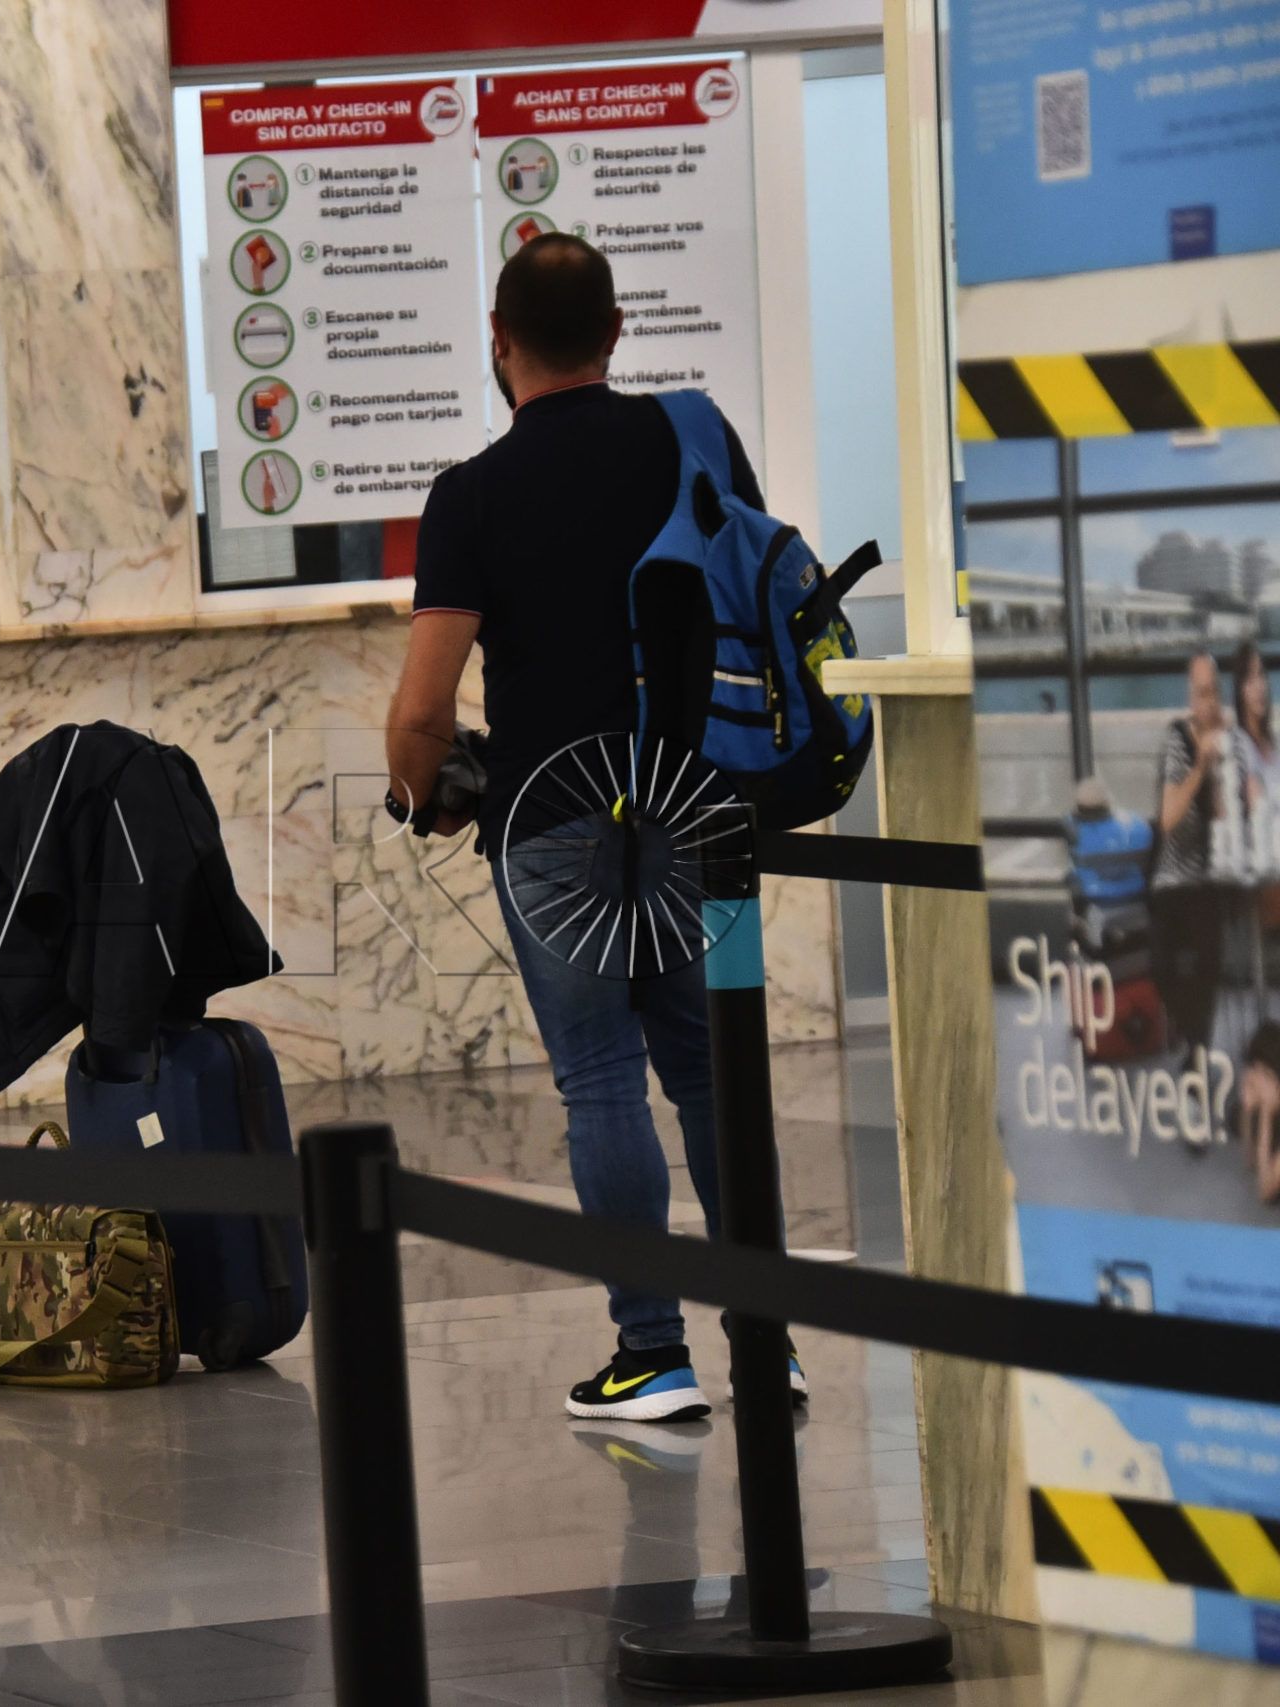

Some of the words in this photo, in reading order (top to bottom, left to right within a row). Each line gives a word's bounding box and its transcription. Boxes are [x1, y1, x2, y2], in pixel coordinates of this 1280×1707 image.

[514, 89, 574, 107] ACHAT
[577, 87, 599, 102] ET
[602, 82, 686, 101] CHECK-IN
[230, 106, 308, 124] COMPRA
[312, 104, 323, 119] Y
[328, 101, 411, 118] CHECK-IN
[534, 107, 581, 124] SANS
[585, 102, 667, 120] CONTACT
[257, 124, 287, 141] SIN
[291, 120, 386, 139] CONTACTO
[594, 146, 677, 161] Respectez
[682, 143, 706, 155] les
[319, 166, 399, 182] Mantenga
[403, 164, 417, 177] la
[594, 164, 673, 179] distances
[677, 161, 697, 174] de
[320, 181, 395, 199] distancia
[399, 181, 419, 195] de
[595, 181, 661, 197] sécurité
[320, 201, 402, 218] seguridad
[597, 222, 671, 237] Préparez
[675, 221, 704, 232] vos
[322, 242, 388, 258] Prepare
[393, 243, 412, 255] su
[598, 240, 686, 254] documents
[323, 258, 448, 276] documentación
[614, 289, 667, 301] cannez
[325, 309, 395, 324] Escanee
[398, 308, 417, 320] su
[326, 327, 379, 344] propia
[633, 321, 722, 336] documents
[327, 342, 452, 359] documentación
[691, 367, 705, 380] le
[329, 389, 459, 407] Recomendamos
[330, 411, 371, 428] pago
[374, 410, 404, 422] con
[407, 406, 462, 421] tarjeta
[334, 462, 382, 477] Retire
[387, 462, 406, 474] su
[334, 481, 355, 494] de
[358, 478, 436, 493] embarqu
[1009, 932, 1116, 1055] Ship
[1019, 1035, 1235, 1159] delayed?
